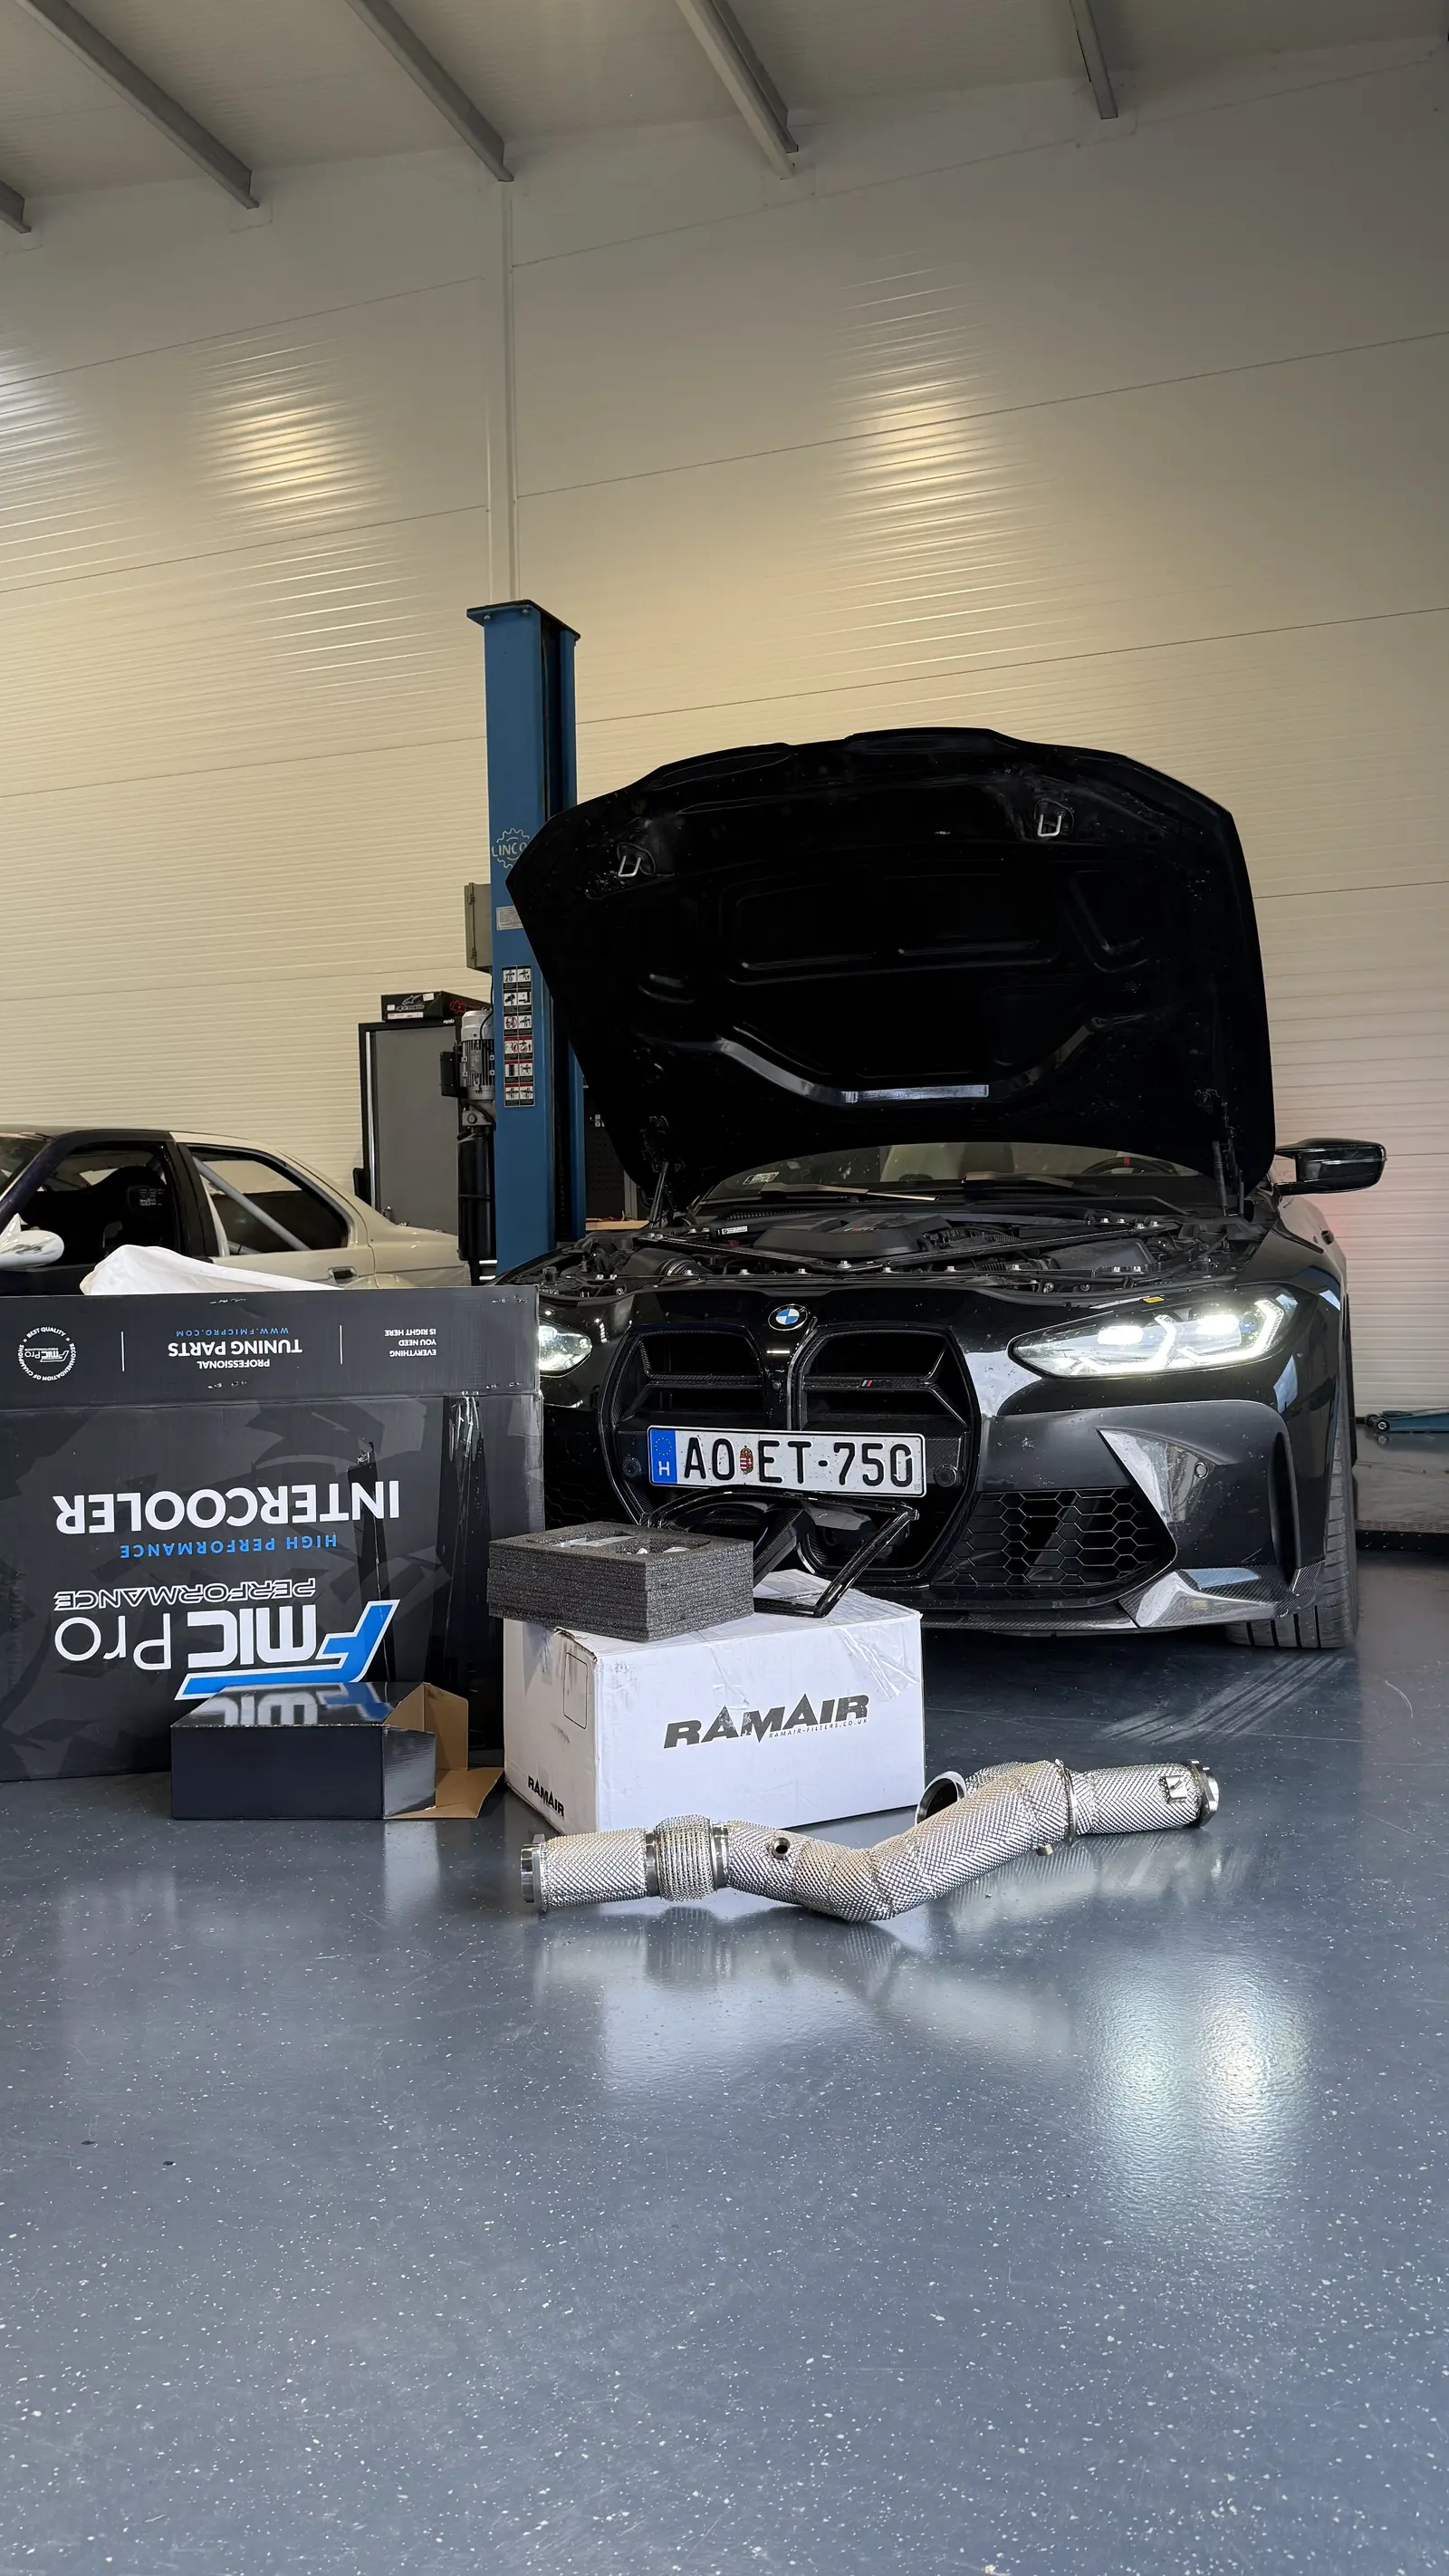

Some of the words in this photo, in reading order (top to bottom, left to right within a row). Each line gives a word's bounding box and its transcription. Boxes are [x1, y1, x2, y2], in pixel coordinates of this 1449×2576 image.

[491, 842, 527, 857] LINCO
[26, 1328, 40, 1338] BEST
[41, 1326, 66, 1337] QUALITY
[176, 1327, 289, 1337] WWW.FMICPRO.COM
[384, 1329, 404, 1337] HERE
[168, 1341, 226, 1357] PARTS
[231, 1339, 302, 1355] TUNING
[398, 1339, 418, 1347] NEED
[389, 1349, 437, 1357] EVERYTHING
[197, 1359, 271, 1370] PROFESSIONAL
[658, 1461, 670, 1476] H
[53, 1480, 399, 1535] INTERCOOLER
[120, 1538, 275, 1559] PERFORMANCE
[286, 1534, 337, 1550] HIGH
[53, 1578, 316, 1610] PERFORMANCE
[54, 1612, 172, 1671] Pro
[664, 1693, 869, 1749] RAMAIR
[769, 1719, 868, 1738] RAMAIR-FILTERS.CO.UK
[528, 1775, 564, 1818] RAMAIR
